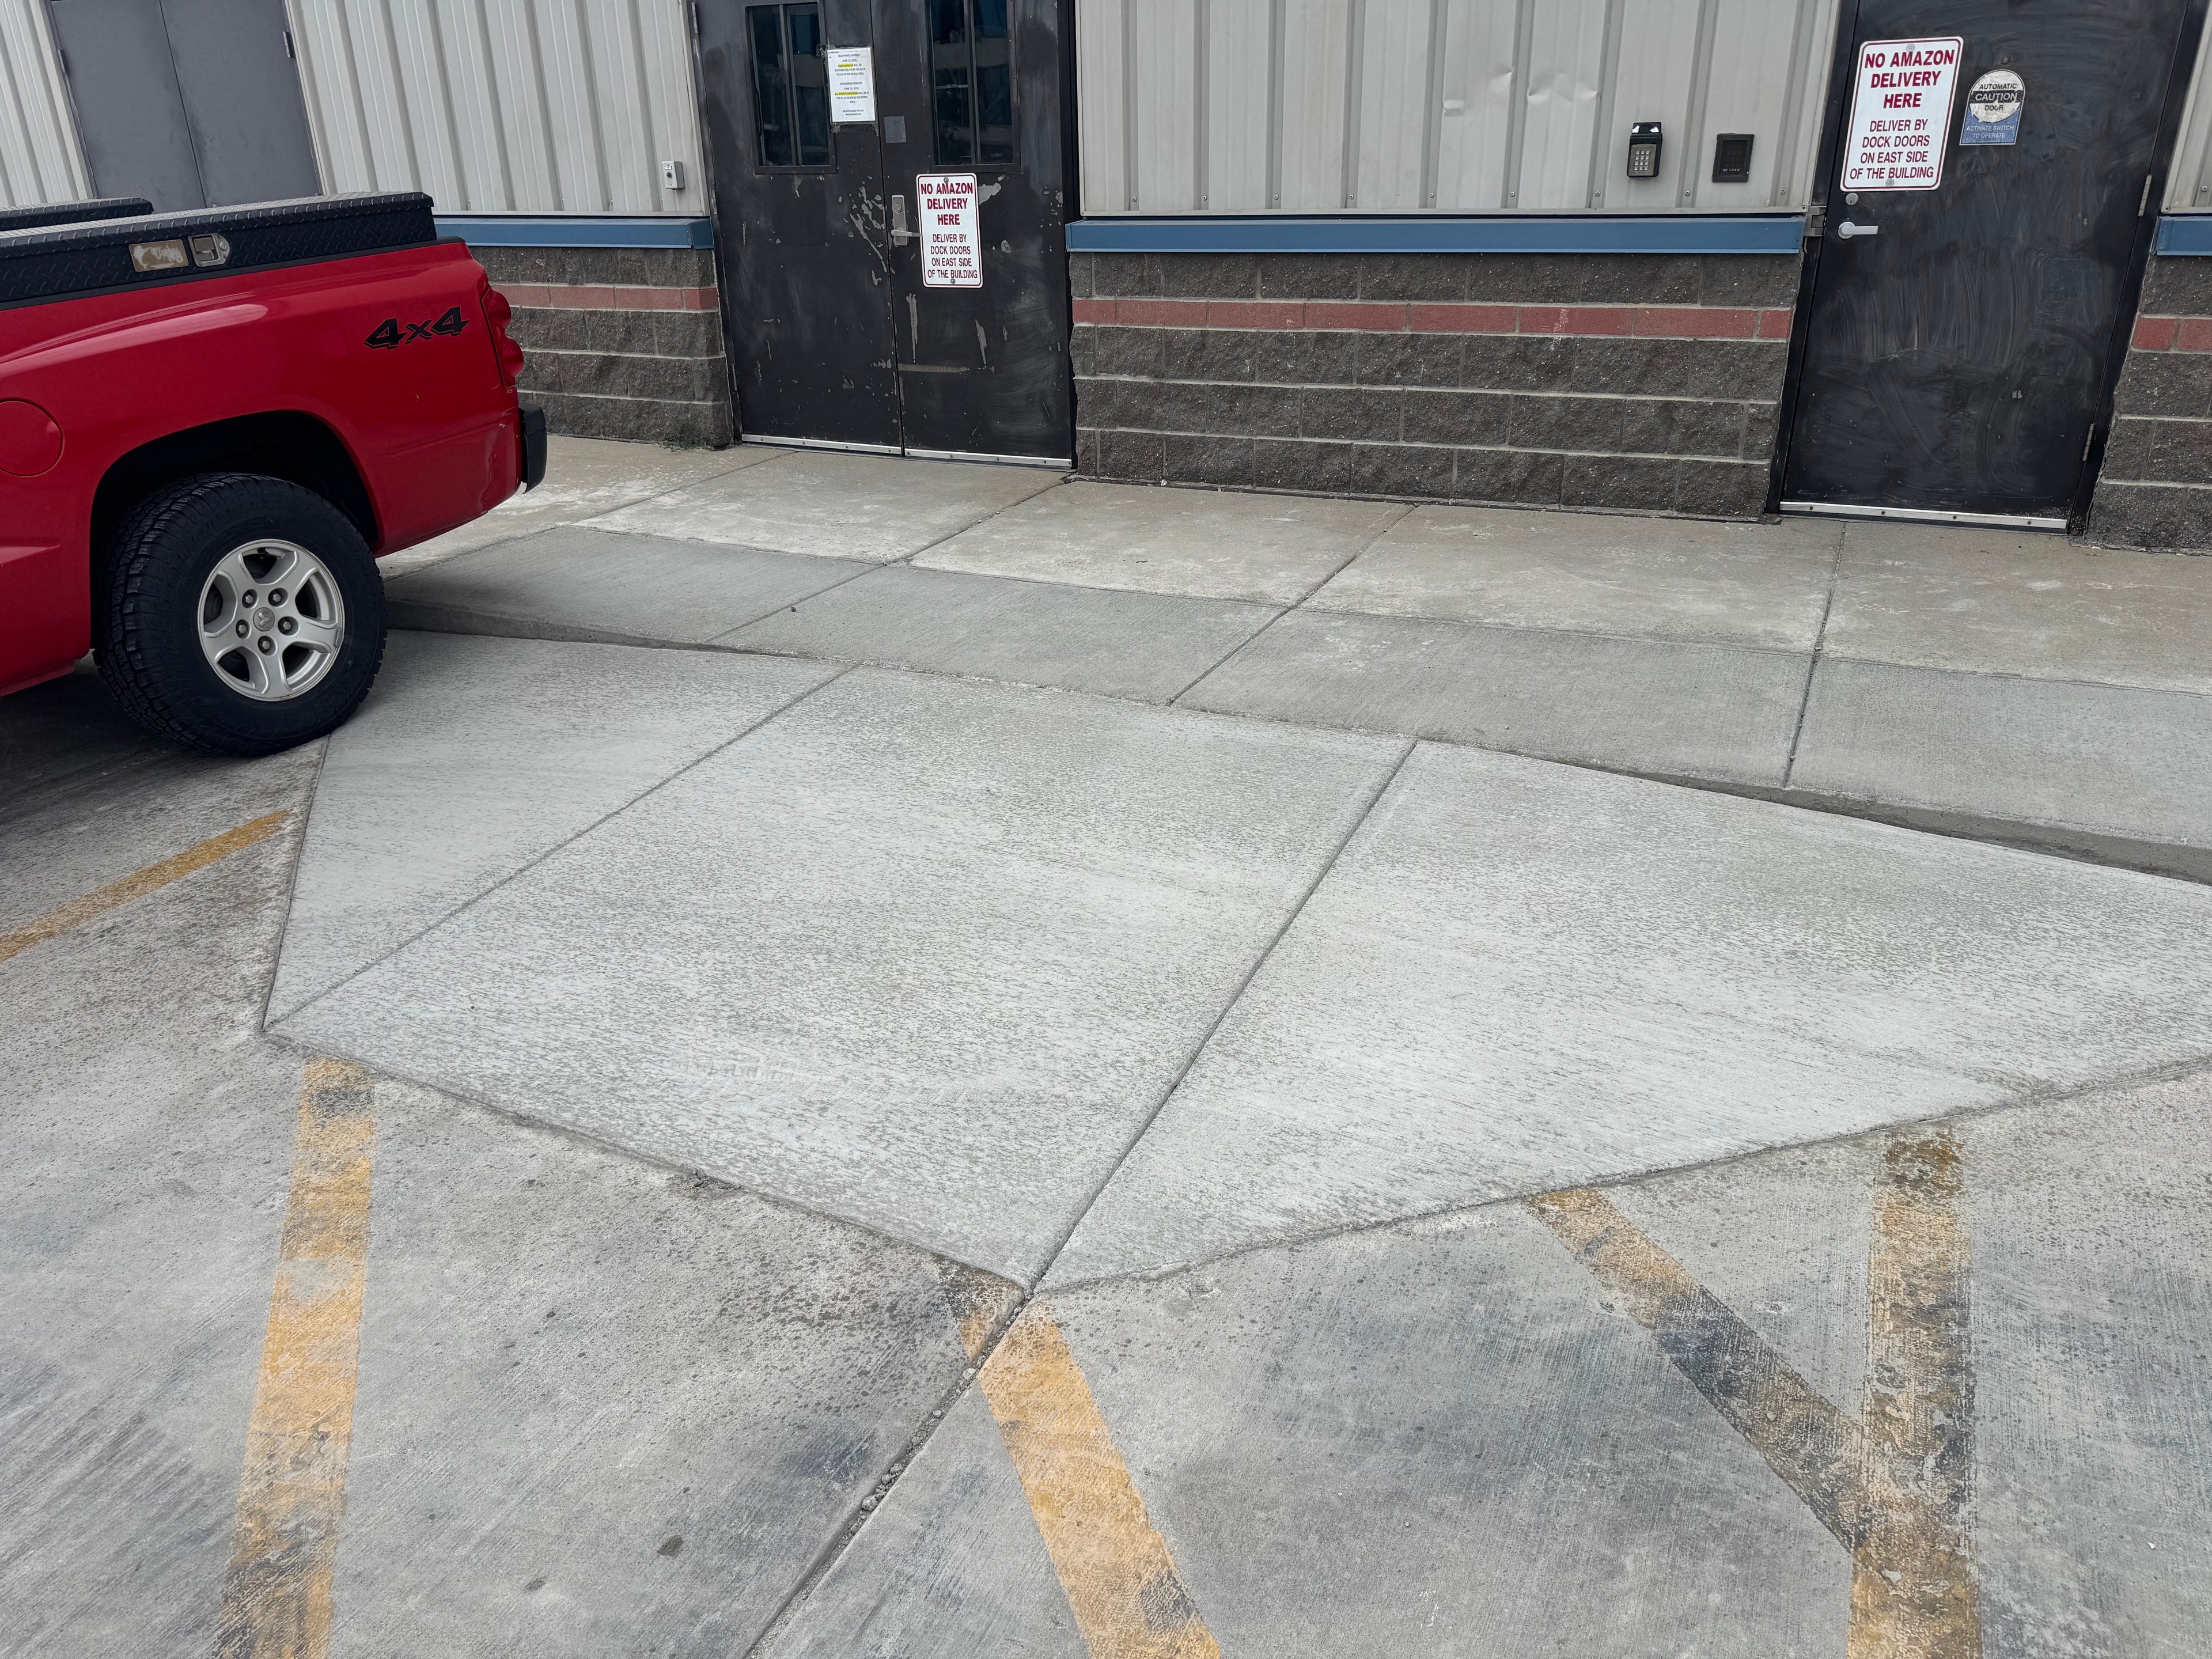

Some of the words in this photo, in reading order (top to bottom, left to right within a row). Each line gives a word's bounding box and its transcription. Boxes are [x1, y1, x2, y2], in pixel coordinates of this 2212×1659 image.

[1865, 53, 1885, 68] NO
[1890, 50, 1955, 67] AMAZON
[1870, 71, 1942, 88] DELIVERY
[1884, 93, 1922, 108] HERE
[1975, 93, 2017, 101] CAUTION
[1870, 119, 1911, 132] DELIVER
[1914, 119, 1928, 131] BY
[1862, 136, 1891, 147] DOCK
[1894, 135, 1930, 147] DOORS
[1861, 152, 1875, 164] ON
[1877, 151, 1903, 163] EAST
[1906, 151, 1928, 162] SIDE
[1850, 168, 1863, 179] OF
[1866, 168, 1885, 179] THE
[1888, 166, 1933, 179] BUILDING
[921, 183, 933, 195] NO
[936, 183, 973, 194] AMAZON
[927, 198, 968, 210] DELIVERY
[937, 214, 960, 225] HERE
[933, 234, 957, 243] DELIVER
[959, 234, 967, 243] BY
[931, 246, 948, 255] DOCK
[950, 246, 971, 255] DOORS
[931, 258, 940, 266] ON
[942, 258, 956, 266] EAST
[959, 258, 972, 266] SIDE
[927, 270, 935, 278] OF
[937, 270, 949, 278] THE
[951, 270, 978, 278] BUILDING
[363, 306, 470, 350] 4x4
